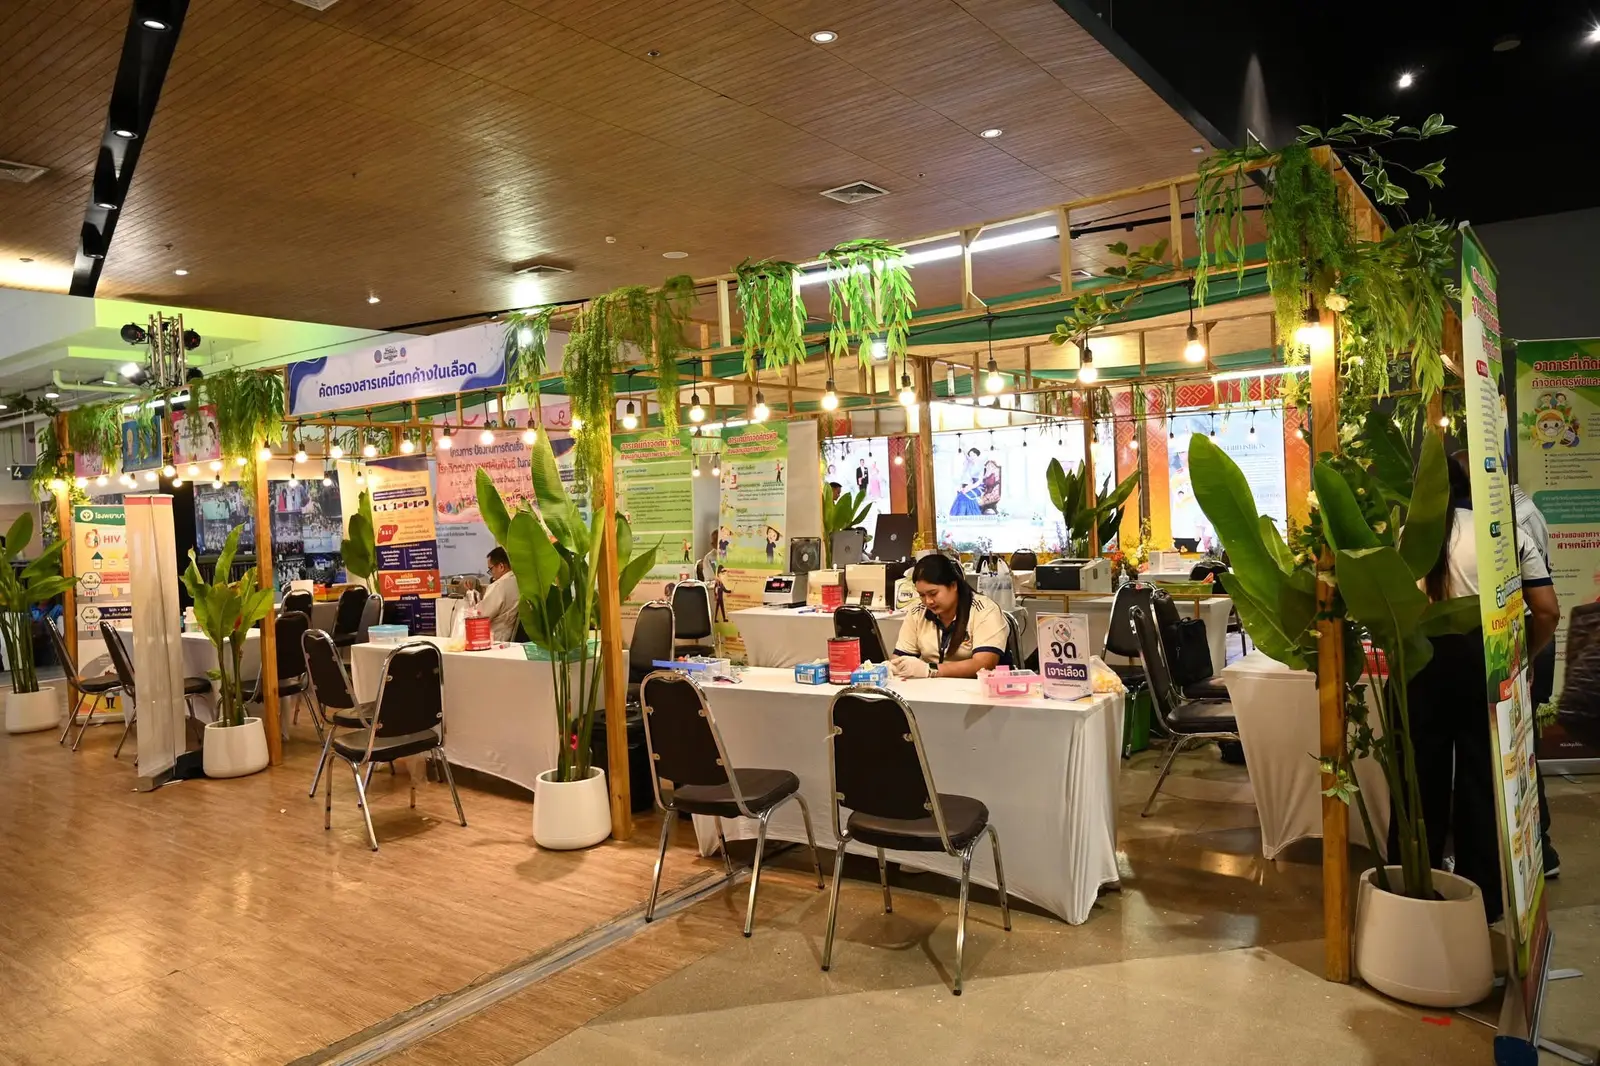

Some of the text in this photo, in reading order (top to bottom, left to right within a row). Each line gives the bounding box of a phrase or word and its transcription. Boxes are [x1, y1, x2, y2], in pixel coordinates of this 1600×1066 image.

[1533, 353, 1600, 371] อาการที่เกิด
[318, 359, 477, 398] คัดกรองสารเคมีตกค้างในเลือด
[13, 466, 22, 478] 4
[103, 535, 121, 544] HIV
[1050, 641, 1077, 663] จุด
[1047, 665, 1085, 678] เจาะเลือด
